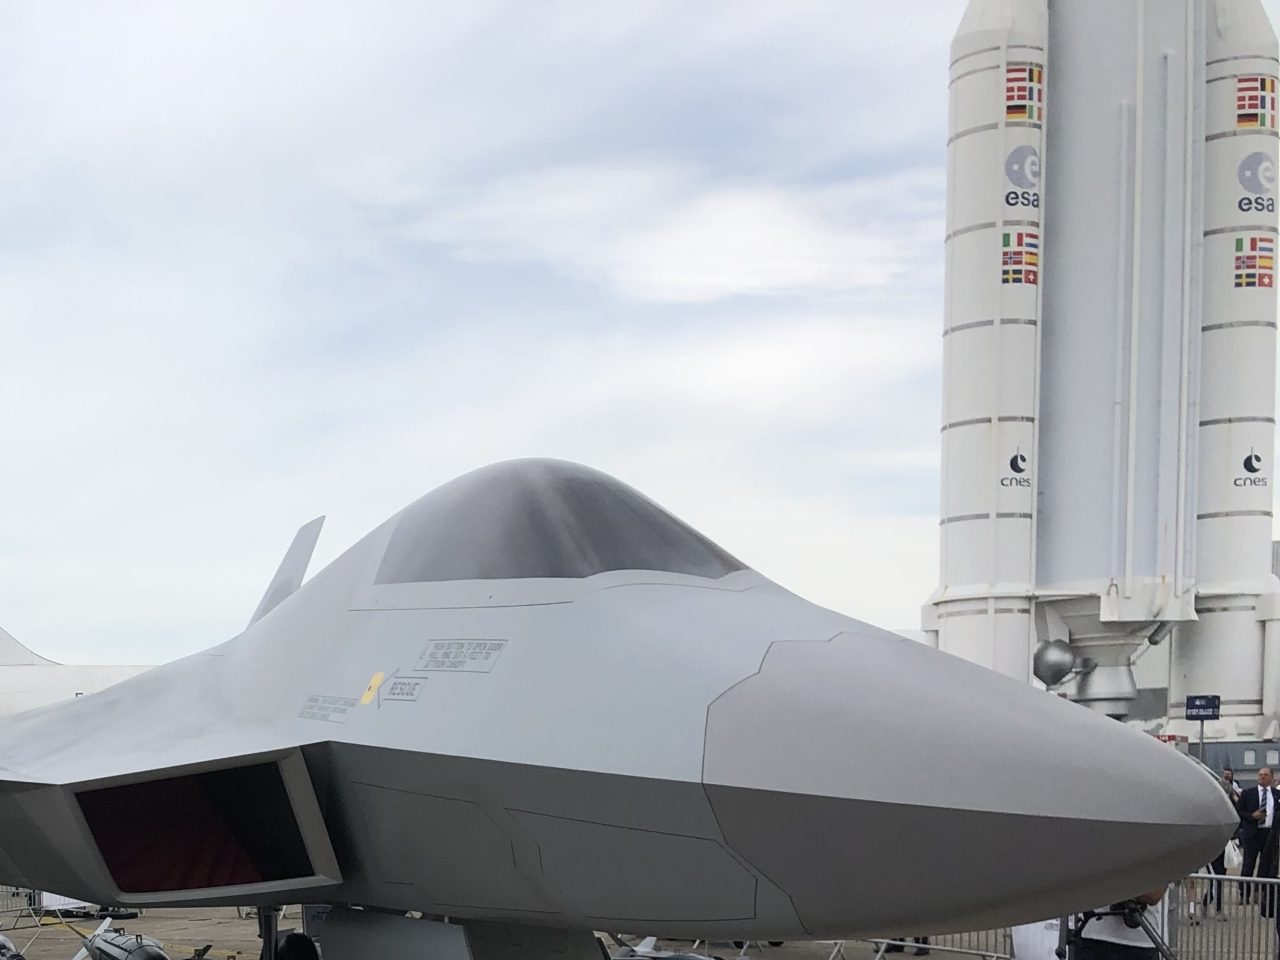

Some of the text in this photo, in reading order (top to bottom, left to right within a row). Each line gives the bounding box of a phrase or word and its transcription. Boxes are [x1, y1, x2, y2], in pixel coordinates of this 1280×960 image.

[1005, 191, 1040, 208] esa
[1237, 196, 1275, 213] esa
[1000, 477, 1031, 487] cnes
[1233, 477, 1268, 487] cnes
